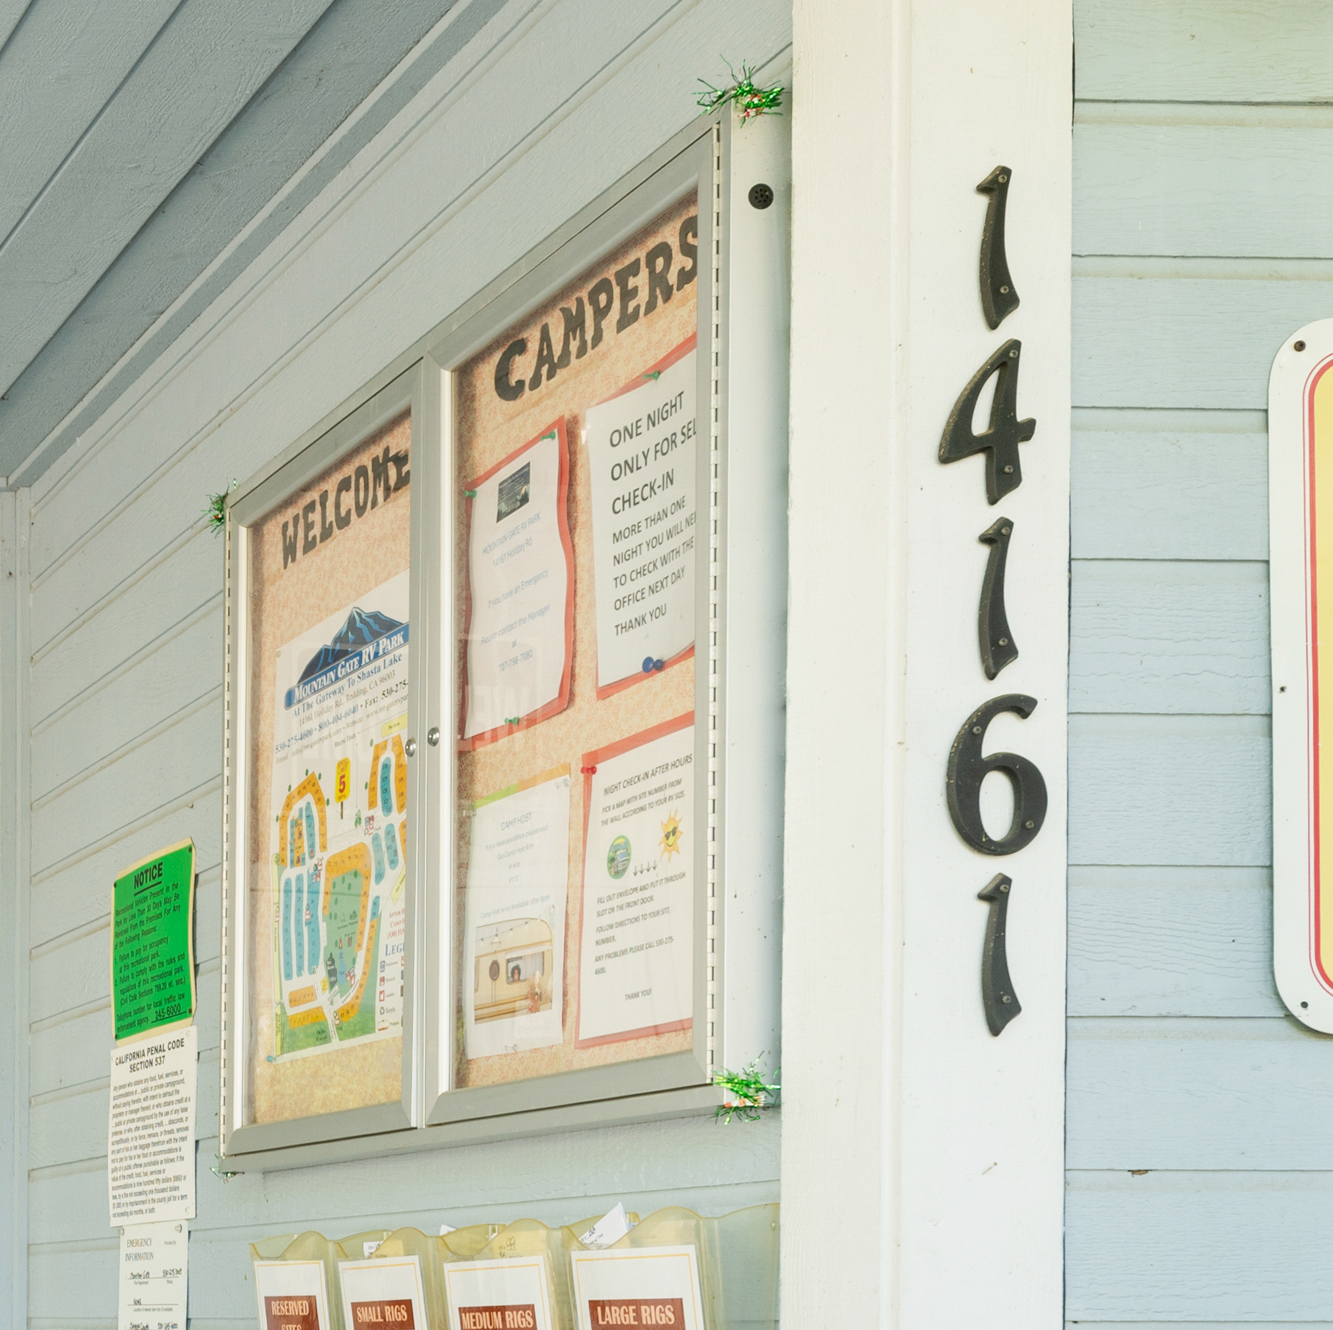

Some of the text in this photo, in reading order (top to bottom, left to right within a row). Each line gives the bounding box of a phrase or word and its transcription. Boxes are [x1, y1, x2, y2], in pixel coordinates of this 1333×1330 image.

[494, 215, 698, 402] CAMPERS
[610, 391, 684, 447] ONE NIGHT
[611, 418, 697, 481] ONLY FOR SEL
[282, 446, 410, 570] WELCOME
[612, 468, 674, 514] CHECK-IN
[613, 495, 685, 544] MORE THAN ONE
[613, 521, 683, 566] NIGHT YOU WILL
[613, 536, 694, 588] TO CHECK WITH THE
[614, 565, 685, 611] OFFICE NEXT DAY
[938, 164, 1049, 1037] 14161
[614, 603, 667, 636] THANK YOU
[293, 653, 402, 718] At The Gateway To Shasta Lake
[294, 631, 404, 703] MOUNTAIN GATE RV PARK
[339, 774, 346, 793] 5
[603, 754, 692, 796] NIGHT CHECK-IN AFTER HOURS
[134, 862, 163, 889] NOTICE
[115, 1038, 184, 1066] CALIFORNIA PENAL CODE
[130, 1055, 165, 1073] SECTION 537
[125, 1252, 154, 1261] INFORMATION
[127, 1238, 152, 1247] EMERGENCY
[272, 1301, 309, 1316] RESERVED
[357, 1305, 407, 1322] SMALL RIGS
[462, 1310, 533, 1329] MEDIUM RIGS
[597, 1305, 675, 1325] LARGE RIGS
